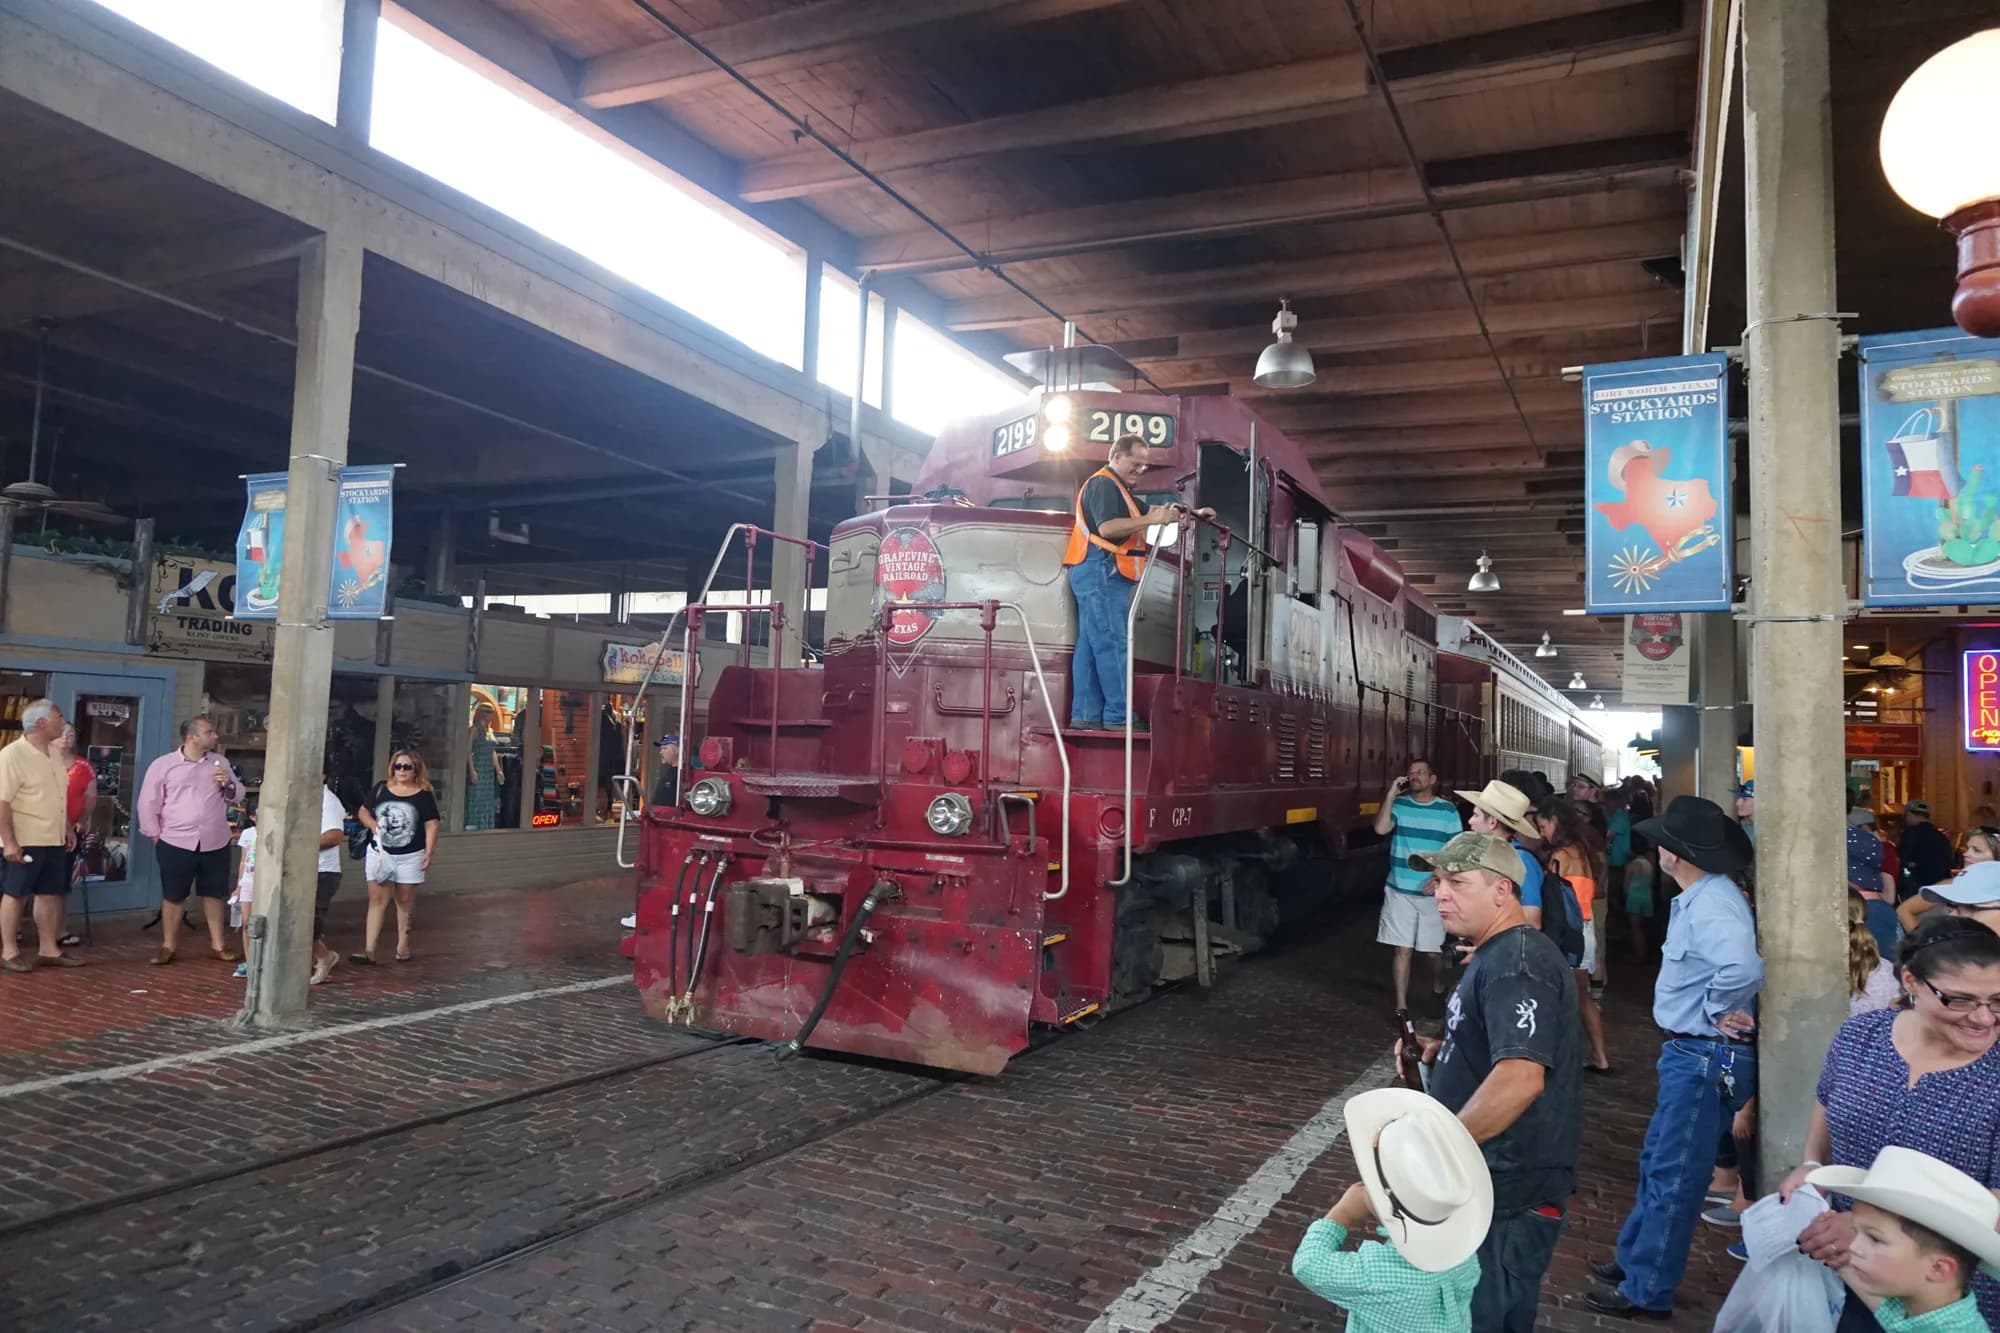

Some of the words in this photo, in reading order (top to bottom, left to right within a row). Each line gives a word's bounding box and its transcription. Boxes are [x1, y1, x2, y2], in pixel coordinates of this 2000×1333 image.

[1590, 392, 1718, 415] STOCKYARDS
[1610, 406, 1693, 424] STATION
[997, 417, 1037, 457] 2199
[1090, 411, 1168, 445] 2199
[879, 550, 936, 565] GRAPEVINE
[884, 561, 927, 573] VINTAGE
[883, 571, 929, 583] RAILROAD
[176, 615, 253, 636] TRADING
[894, 623, 919, 634] EXAS
[1979, 654, 1999, 727] OPEN
[532, 815, 559, 825] OPEN
[1150, 808, 1157, 828] F
